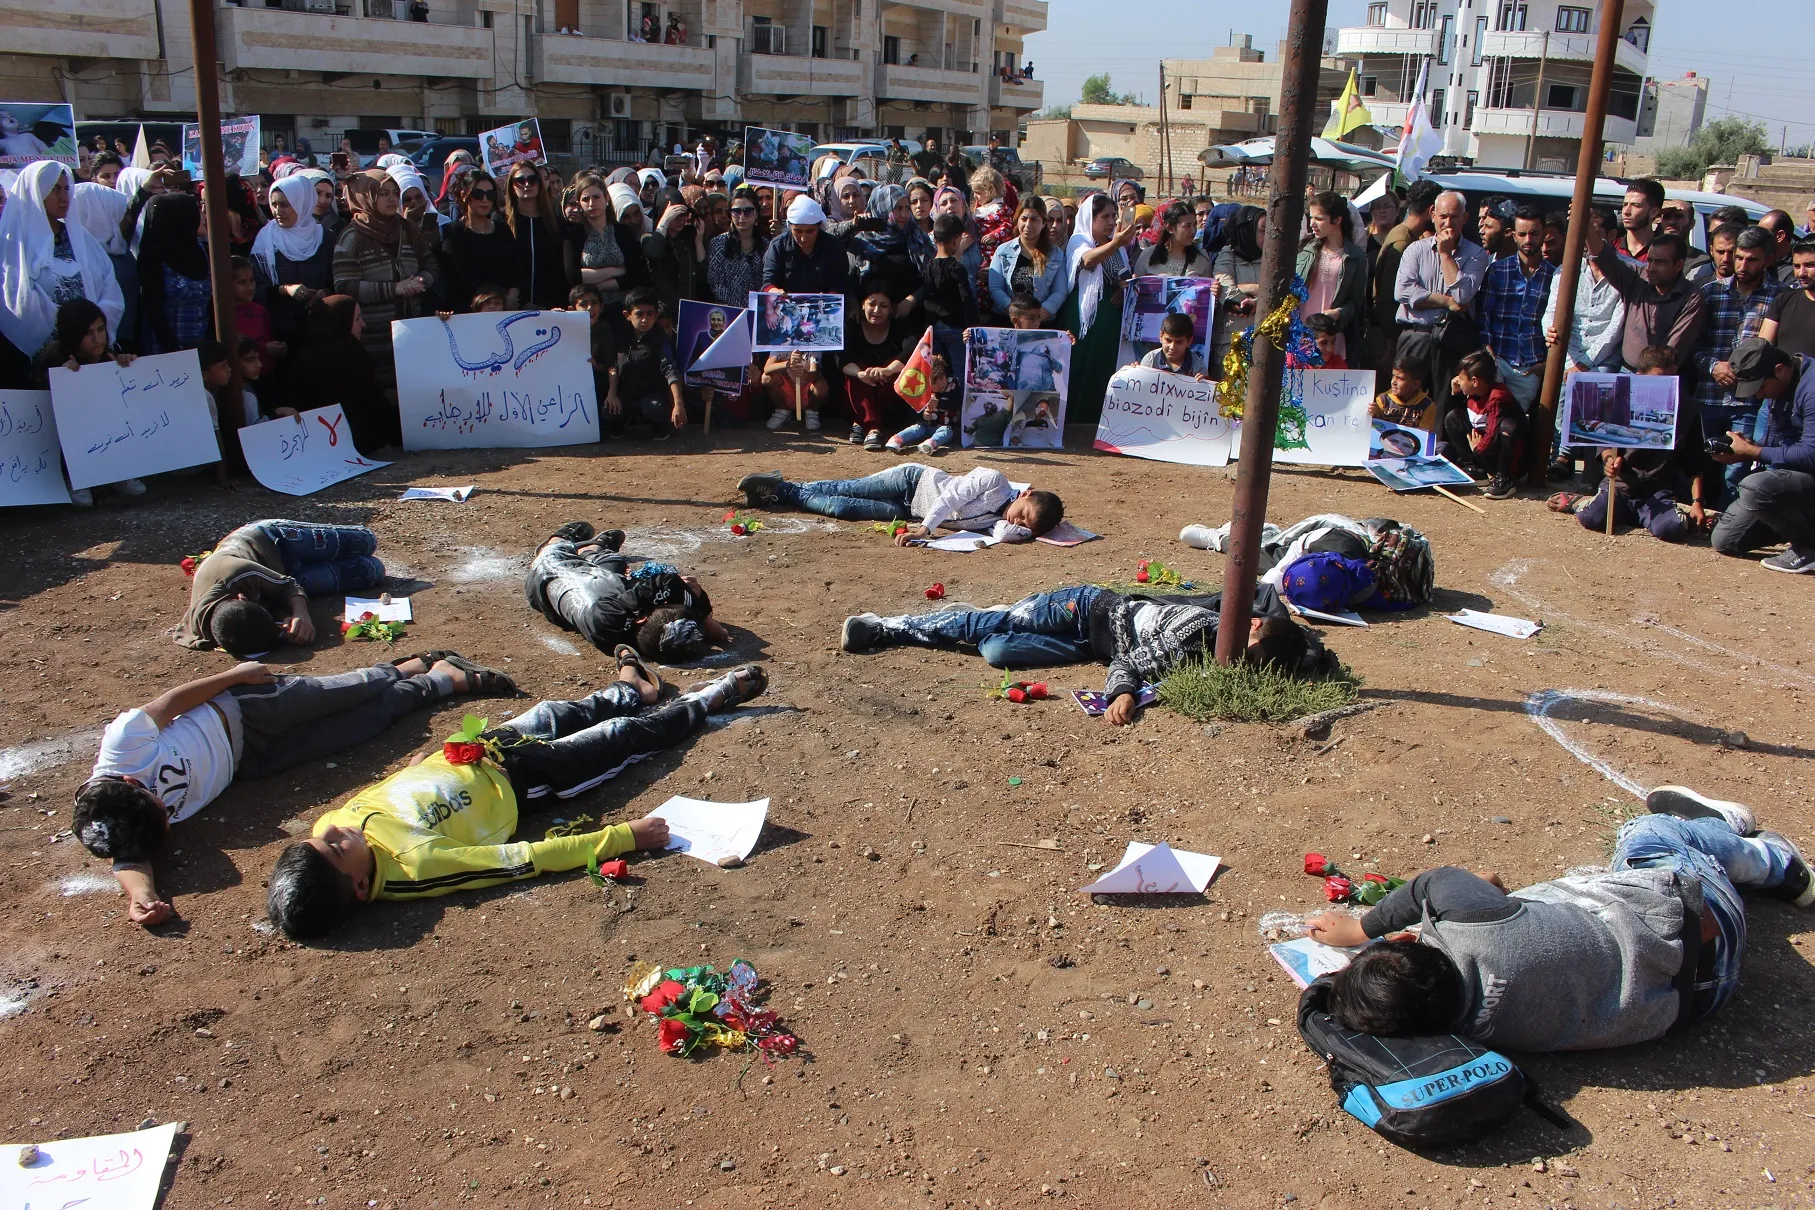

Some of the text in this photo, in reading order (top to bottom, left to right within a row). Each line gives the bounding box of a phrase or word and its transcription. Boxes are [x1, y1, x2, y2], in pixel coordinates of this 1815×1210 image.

[442, 310, 561, 372] تركيا
[143, 369, 165, 392] أن
[169, 372, 189, 389] نريد
[1313, 373, 1368, 397] Kuştina
[1182, 405, 1218, 429] bijîn
[115, 421, 135, 444] أن
[318, 413, 343, 447] لا
[1475, 974, 1508, 1026] SPORT
[25, 1148, 143, 1188] المقاومة
